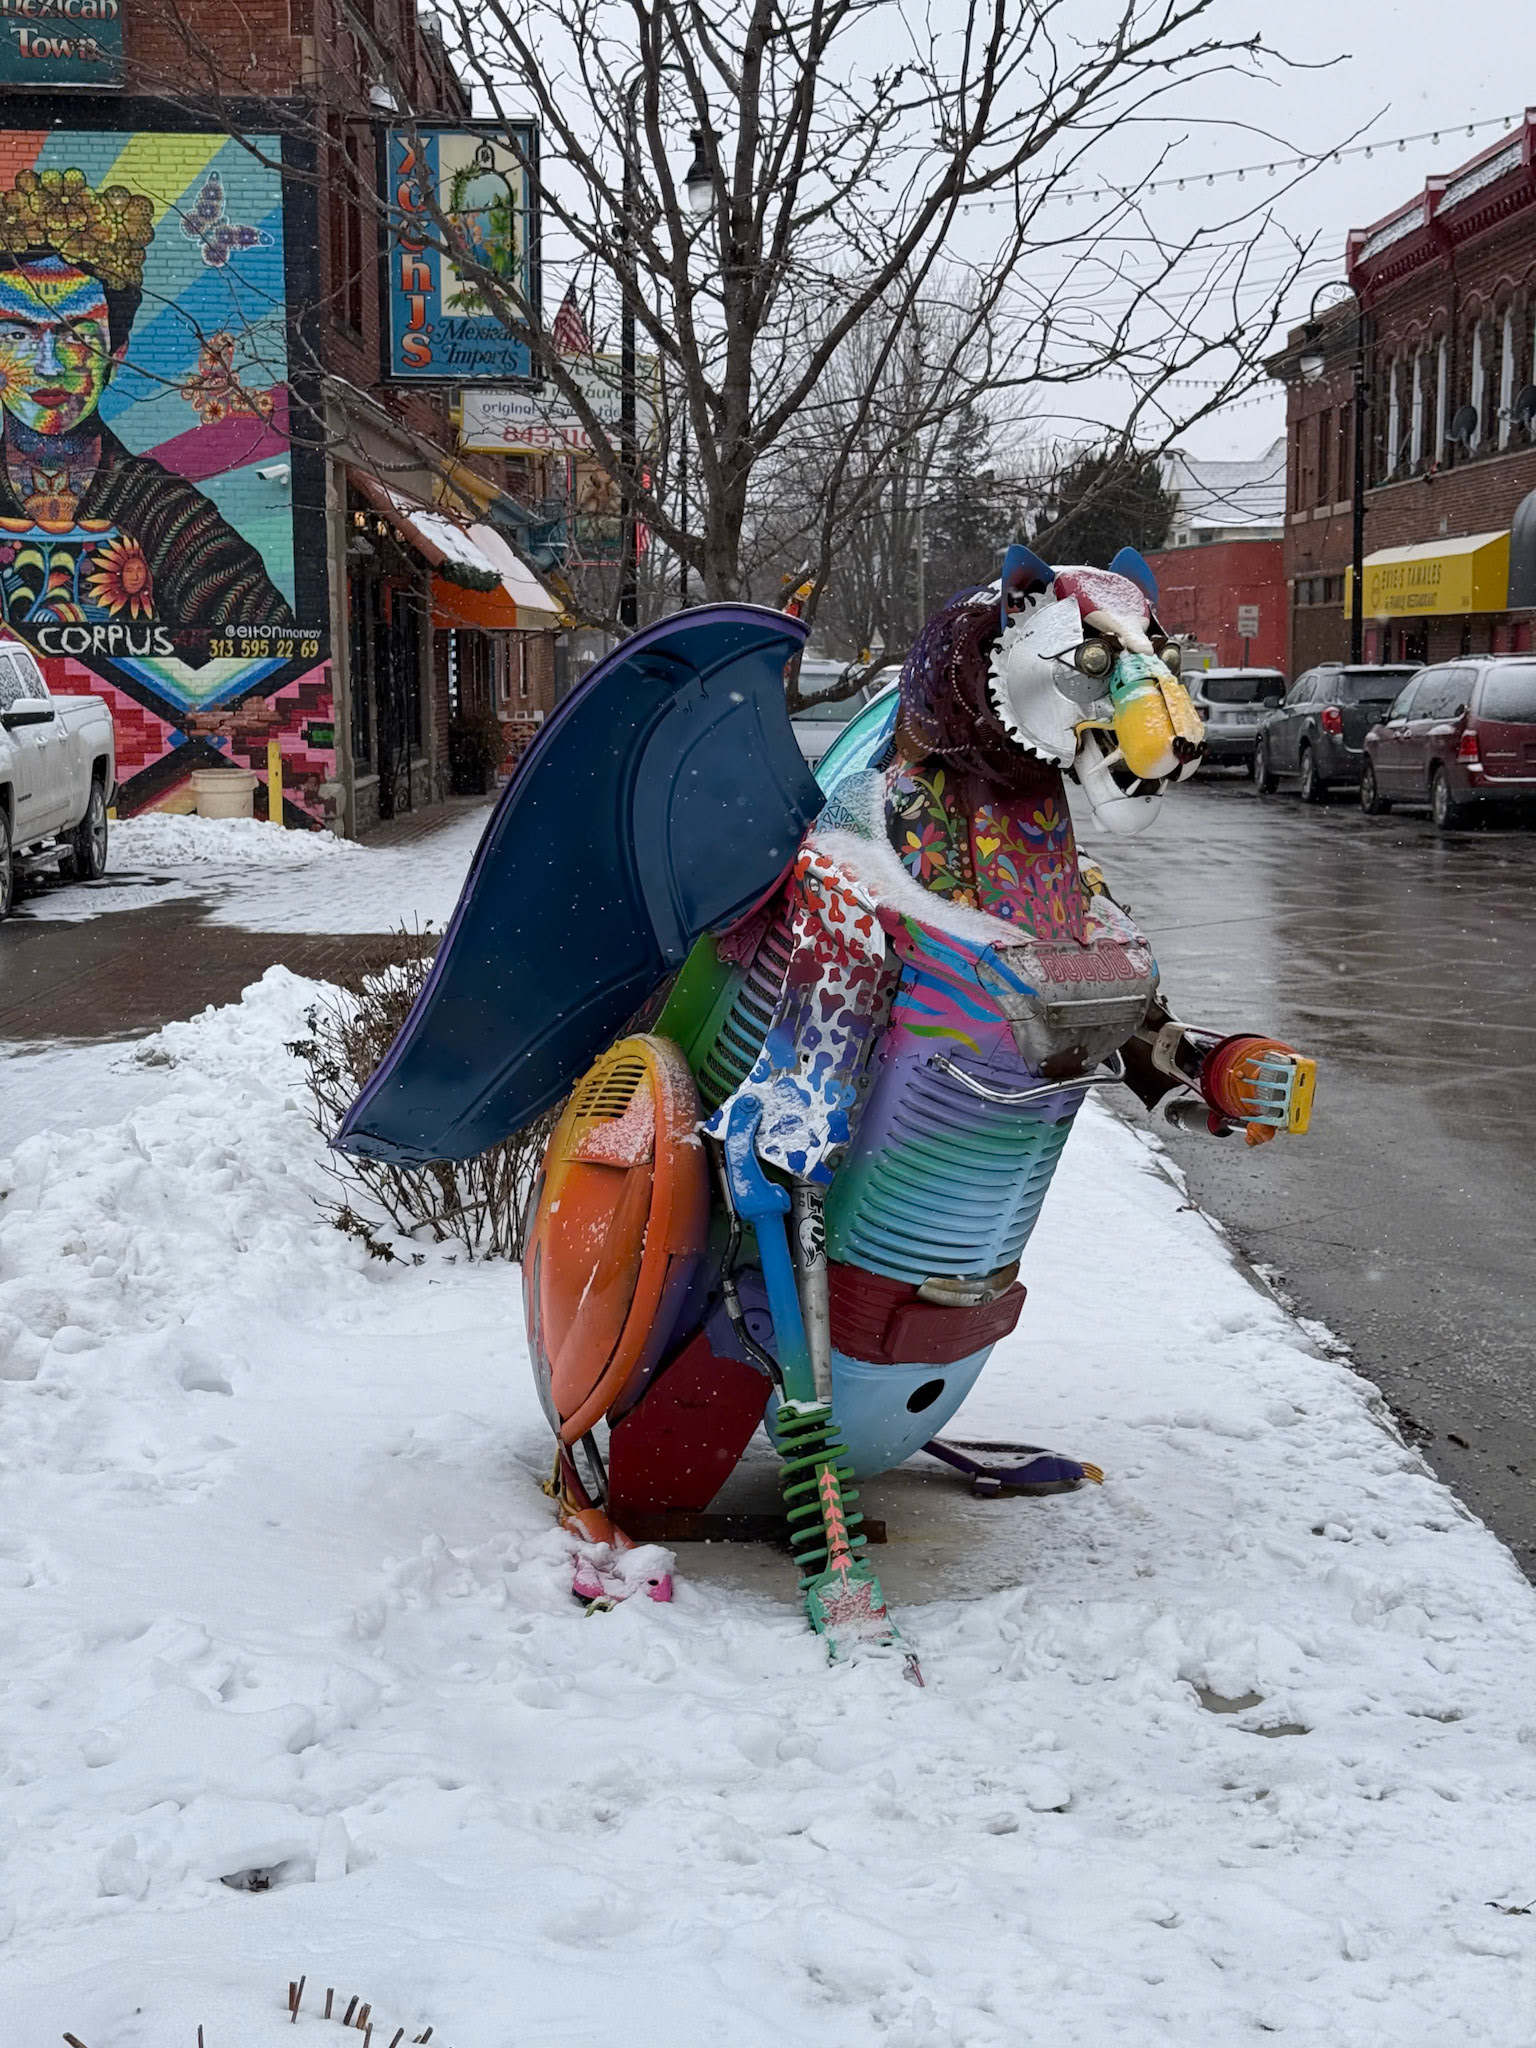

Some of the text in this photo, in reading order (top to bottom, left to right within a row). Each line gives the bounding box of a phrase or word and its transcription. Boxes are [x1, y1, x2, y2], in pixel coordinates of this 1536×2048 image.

[10, 27, 97, 59] Town
[441, 341, 518, 372] Imports
[1407, 564, 1442, 587] TAMALES
[37, 624, 174, 656] CORPUS
[209, 639, 319, 658] 313 595 22 69
